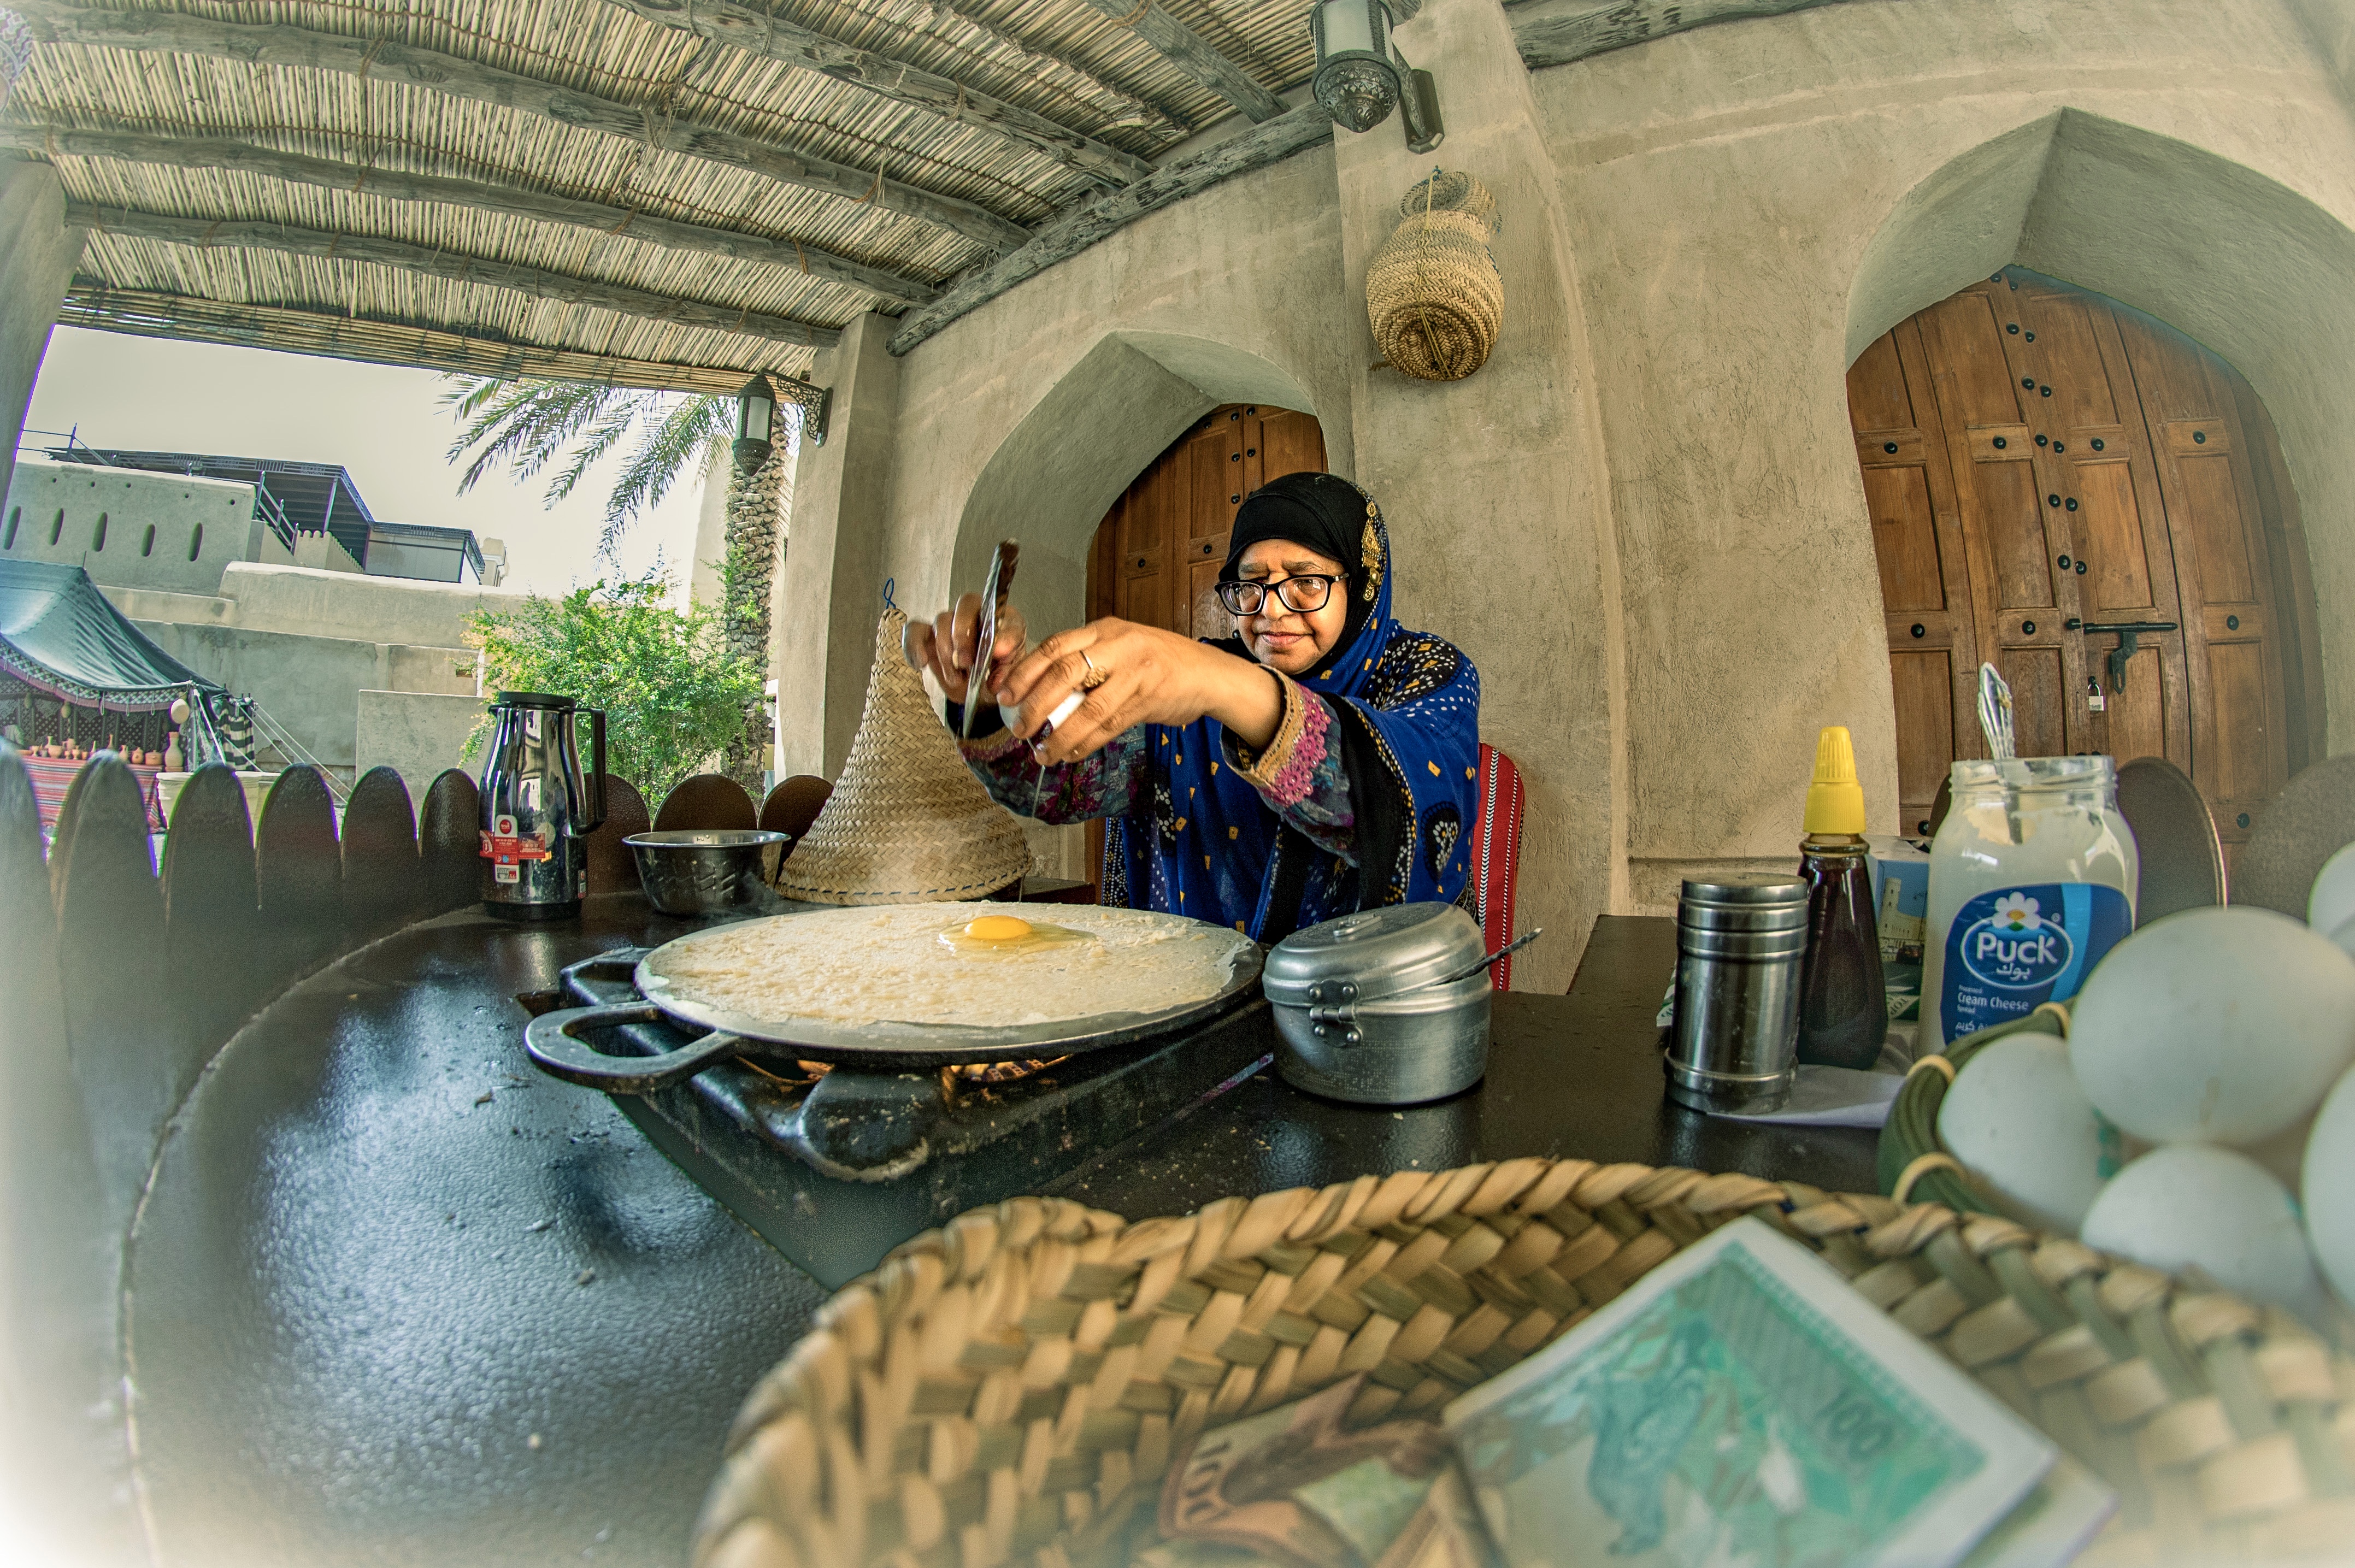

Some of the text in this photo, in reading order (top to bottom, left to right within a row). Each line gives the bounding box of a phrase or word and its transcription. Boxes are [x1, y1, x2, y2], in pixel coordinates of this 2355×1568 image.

[1976, 932, 2059, 965] Puck
[1958, 992, 2029, 1011] Cream Cheese
[1813, 1387, 1894, 1463] 100
